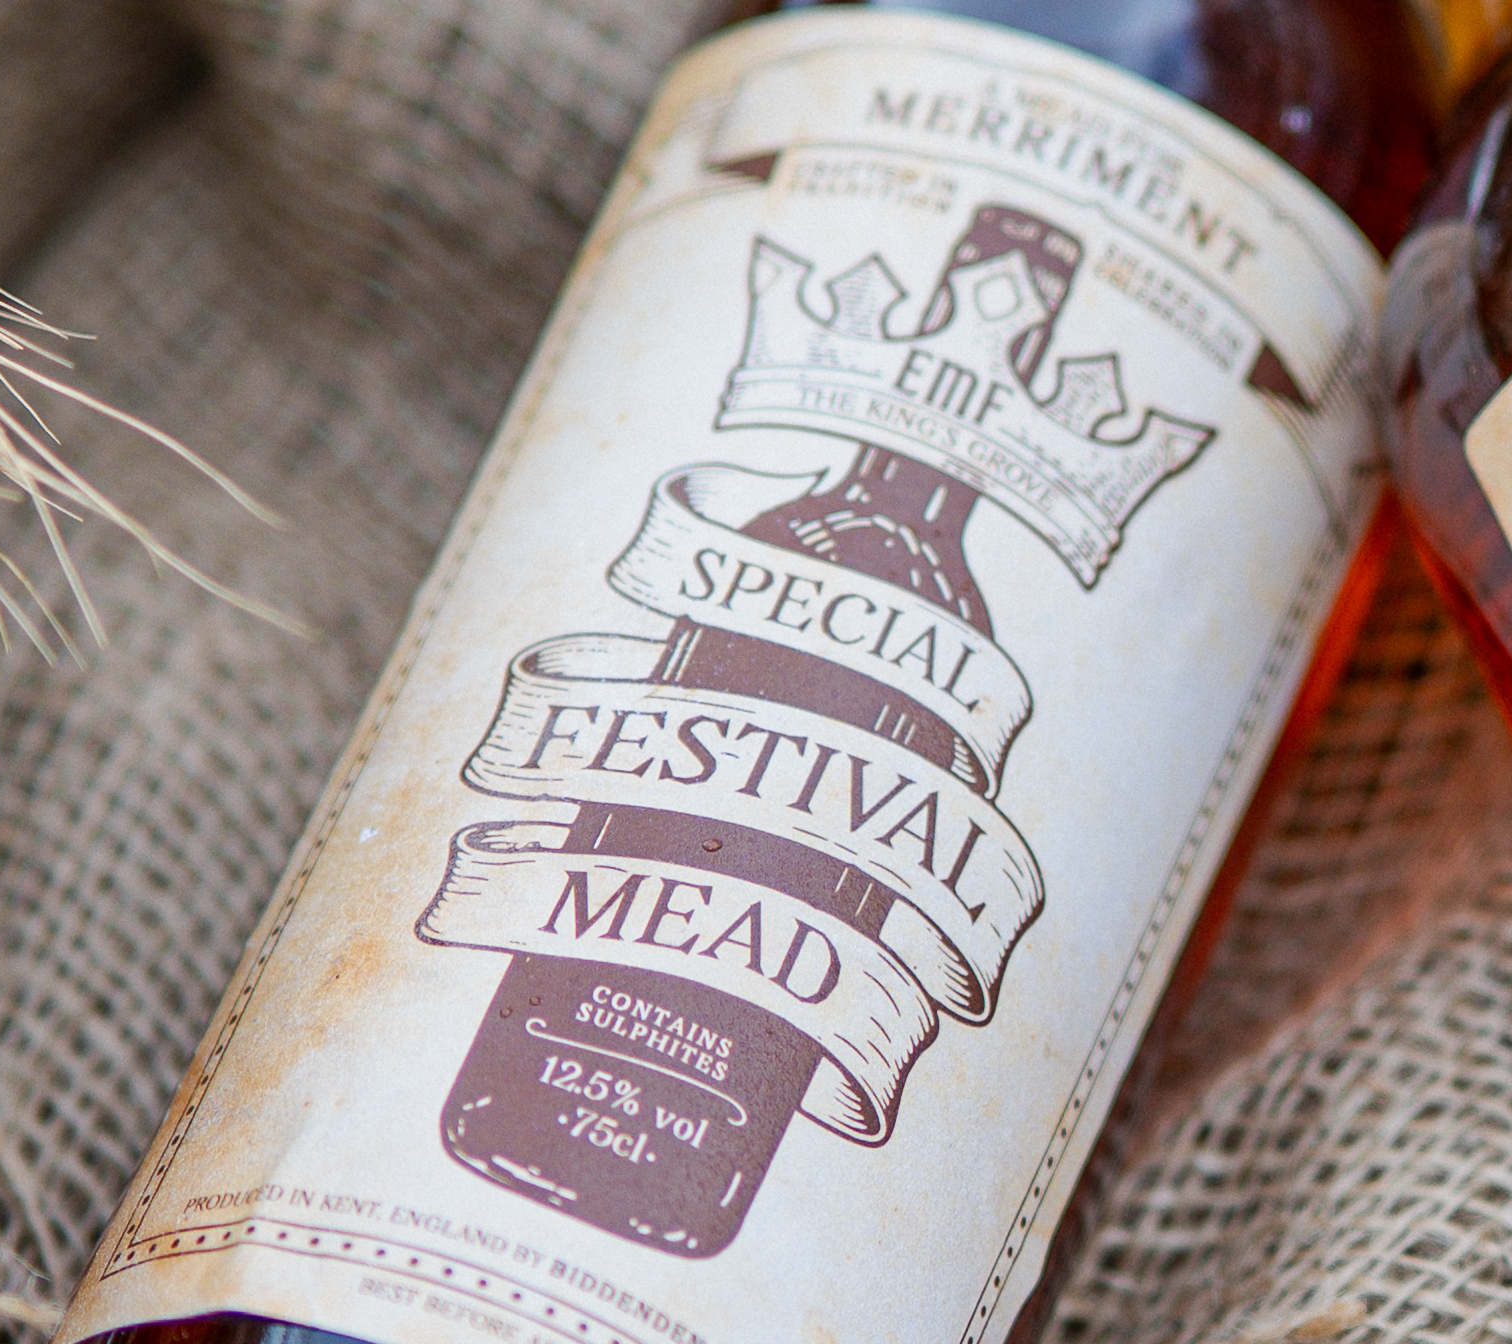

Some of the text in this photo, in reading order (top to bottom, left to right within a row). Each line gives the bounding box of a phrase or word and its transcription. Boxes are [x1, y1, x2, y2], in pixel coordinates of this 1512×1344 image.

[863, 88, 1259, 276] MERRIMENT
[893, 347, 1014, 425] EMF
[798, 386, 1062, 510] THE KING'S GROVE
[678, 548, 982, 714] SPECIAL
[520, 705, 989, 924] FESTIVAL
[541, 869, 842, 1005] MEAD
[575, 1003, 729, 1081] SULPHITES
[592, 985, 732, 1058] CONTAINS
[539, 1056, 709, 1149] 12.5% vol
[183, 1183, 284, 1215] PRODUCED
[290, 1188, 311, 1207] IN
[389, 1206, 508, 1256] ENGLAND
[513, 1244, 546, 1269] BY
